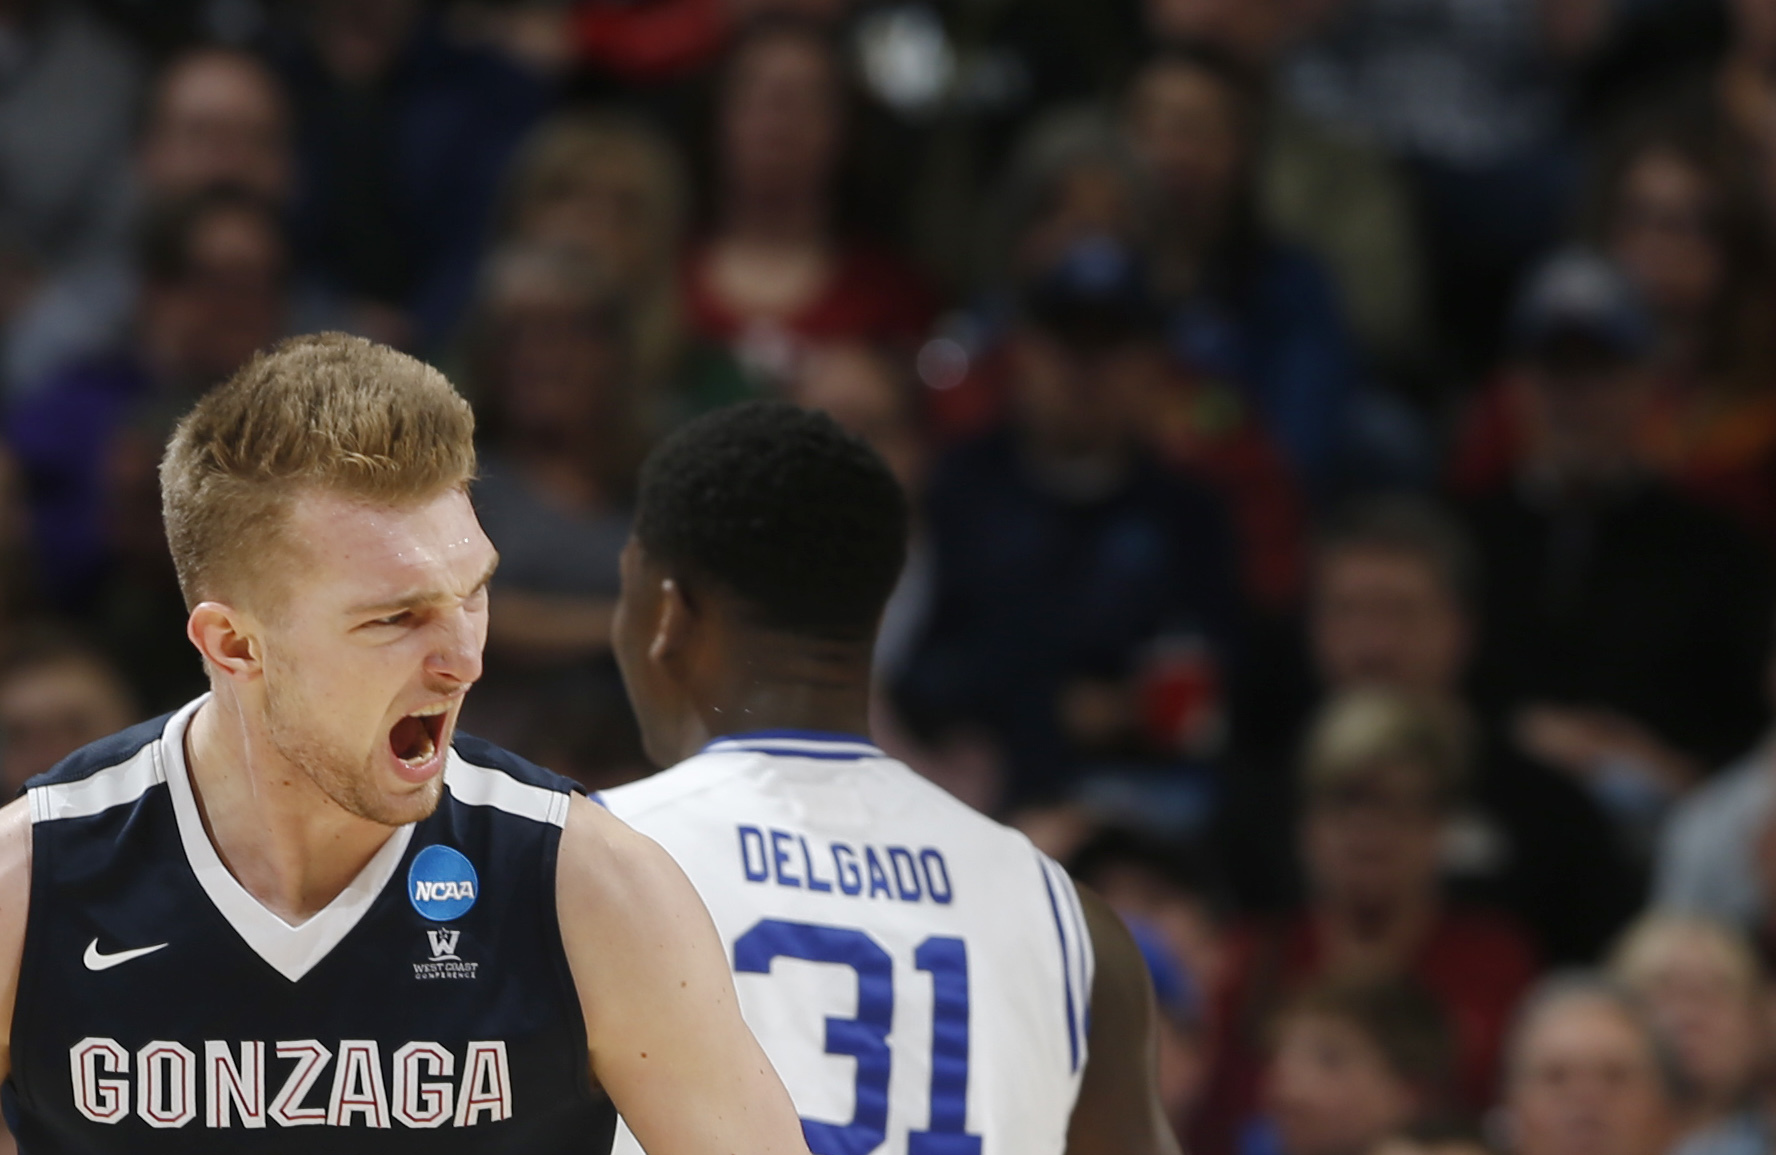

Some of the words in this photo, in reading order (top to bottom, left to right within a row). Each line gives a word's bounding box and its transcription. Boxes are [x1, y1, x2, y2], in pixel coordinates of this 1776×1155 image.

[736, 824, 954, 905] DELGADO
[415, 880, 475, 901] NCAA
[412, 963, 444, 973] WEST
[445, 962, 478, 972] COAST
[69, 1036, 513, 1129] GONZAGA
